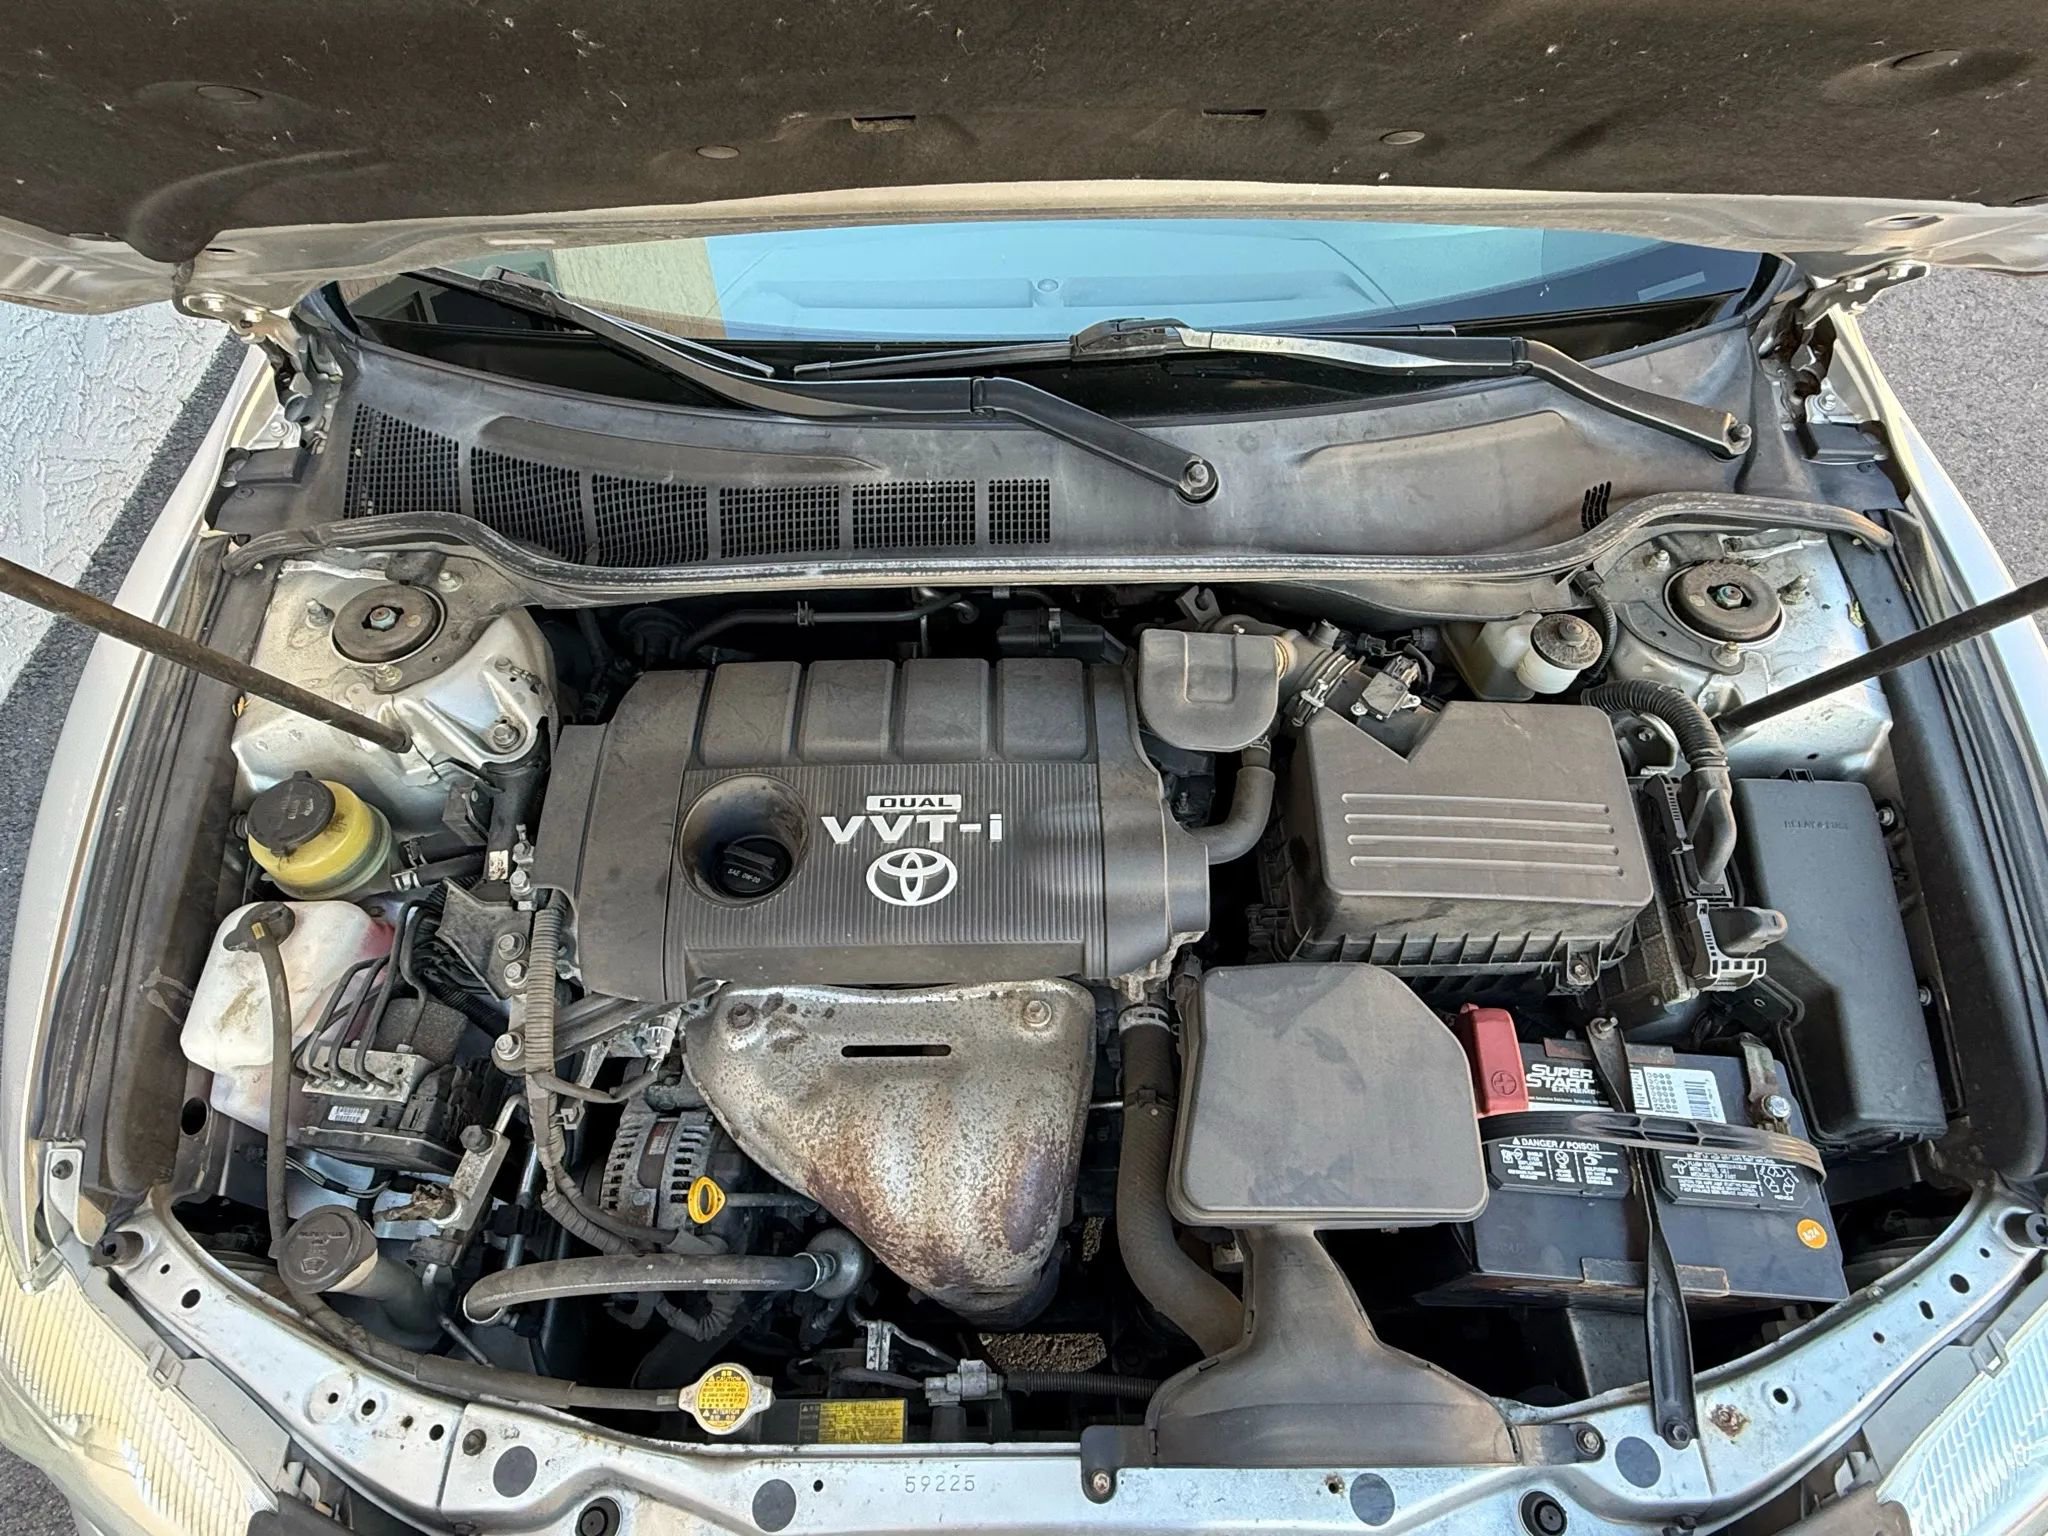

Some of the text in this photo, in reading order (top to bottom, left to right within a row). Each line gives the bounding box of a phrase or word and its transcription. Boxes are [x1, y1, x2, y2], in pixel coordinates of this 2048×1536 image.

[879, 798, 953, 808] DUAL
[820, 813, 1003, 845] VVT-i
[1531, 1063, 1593, 1080] SUPER
[1525, 1072, 1596, 1091] START
[1521, 1137, 1559, 1149] DANGER
[1566, 1140, 1600, 1152] POISON
[905, 1474, 976, 1494] 59225
